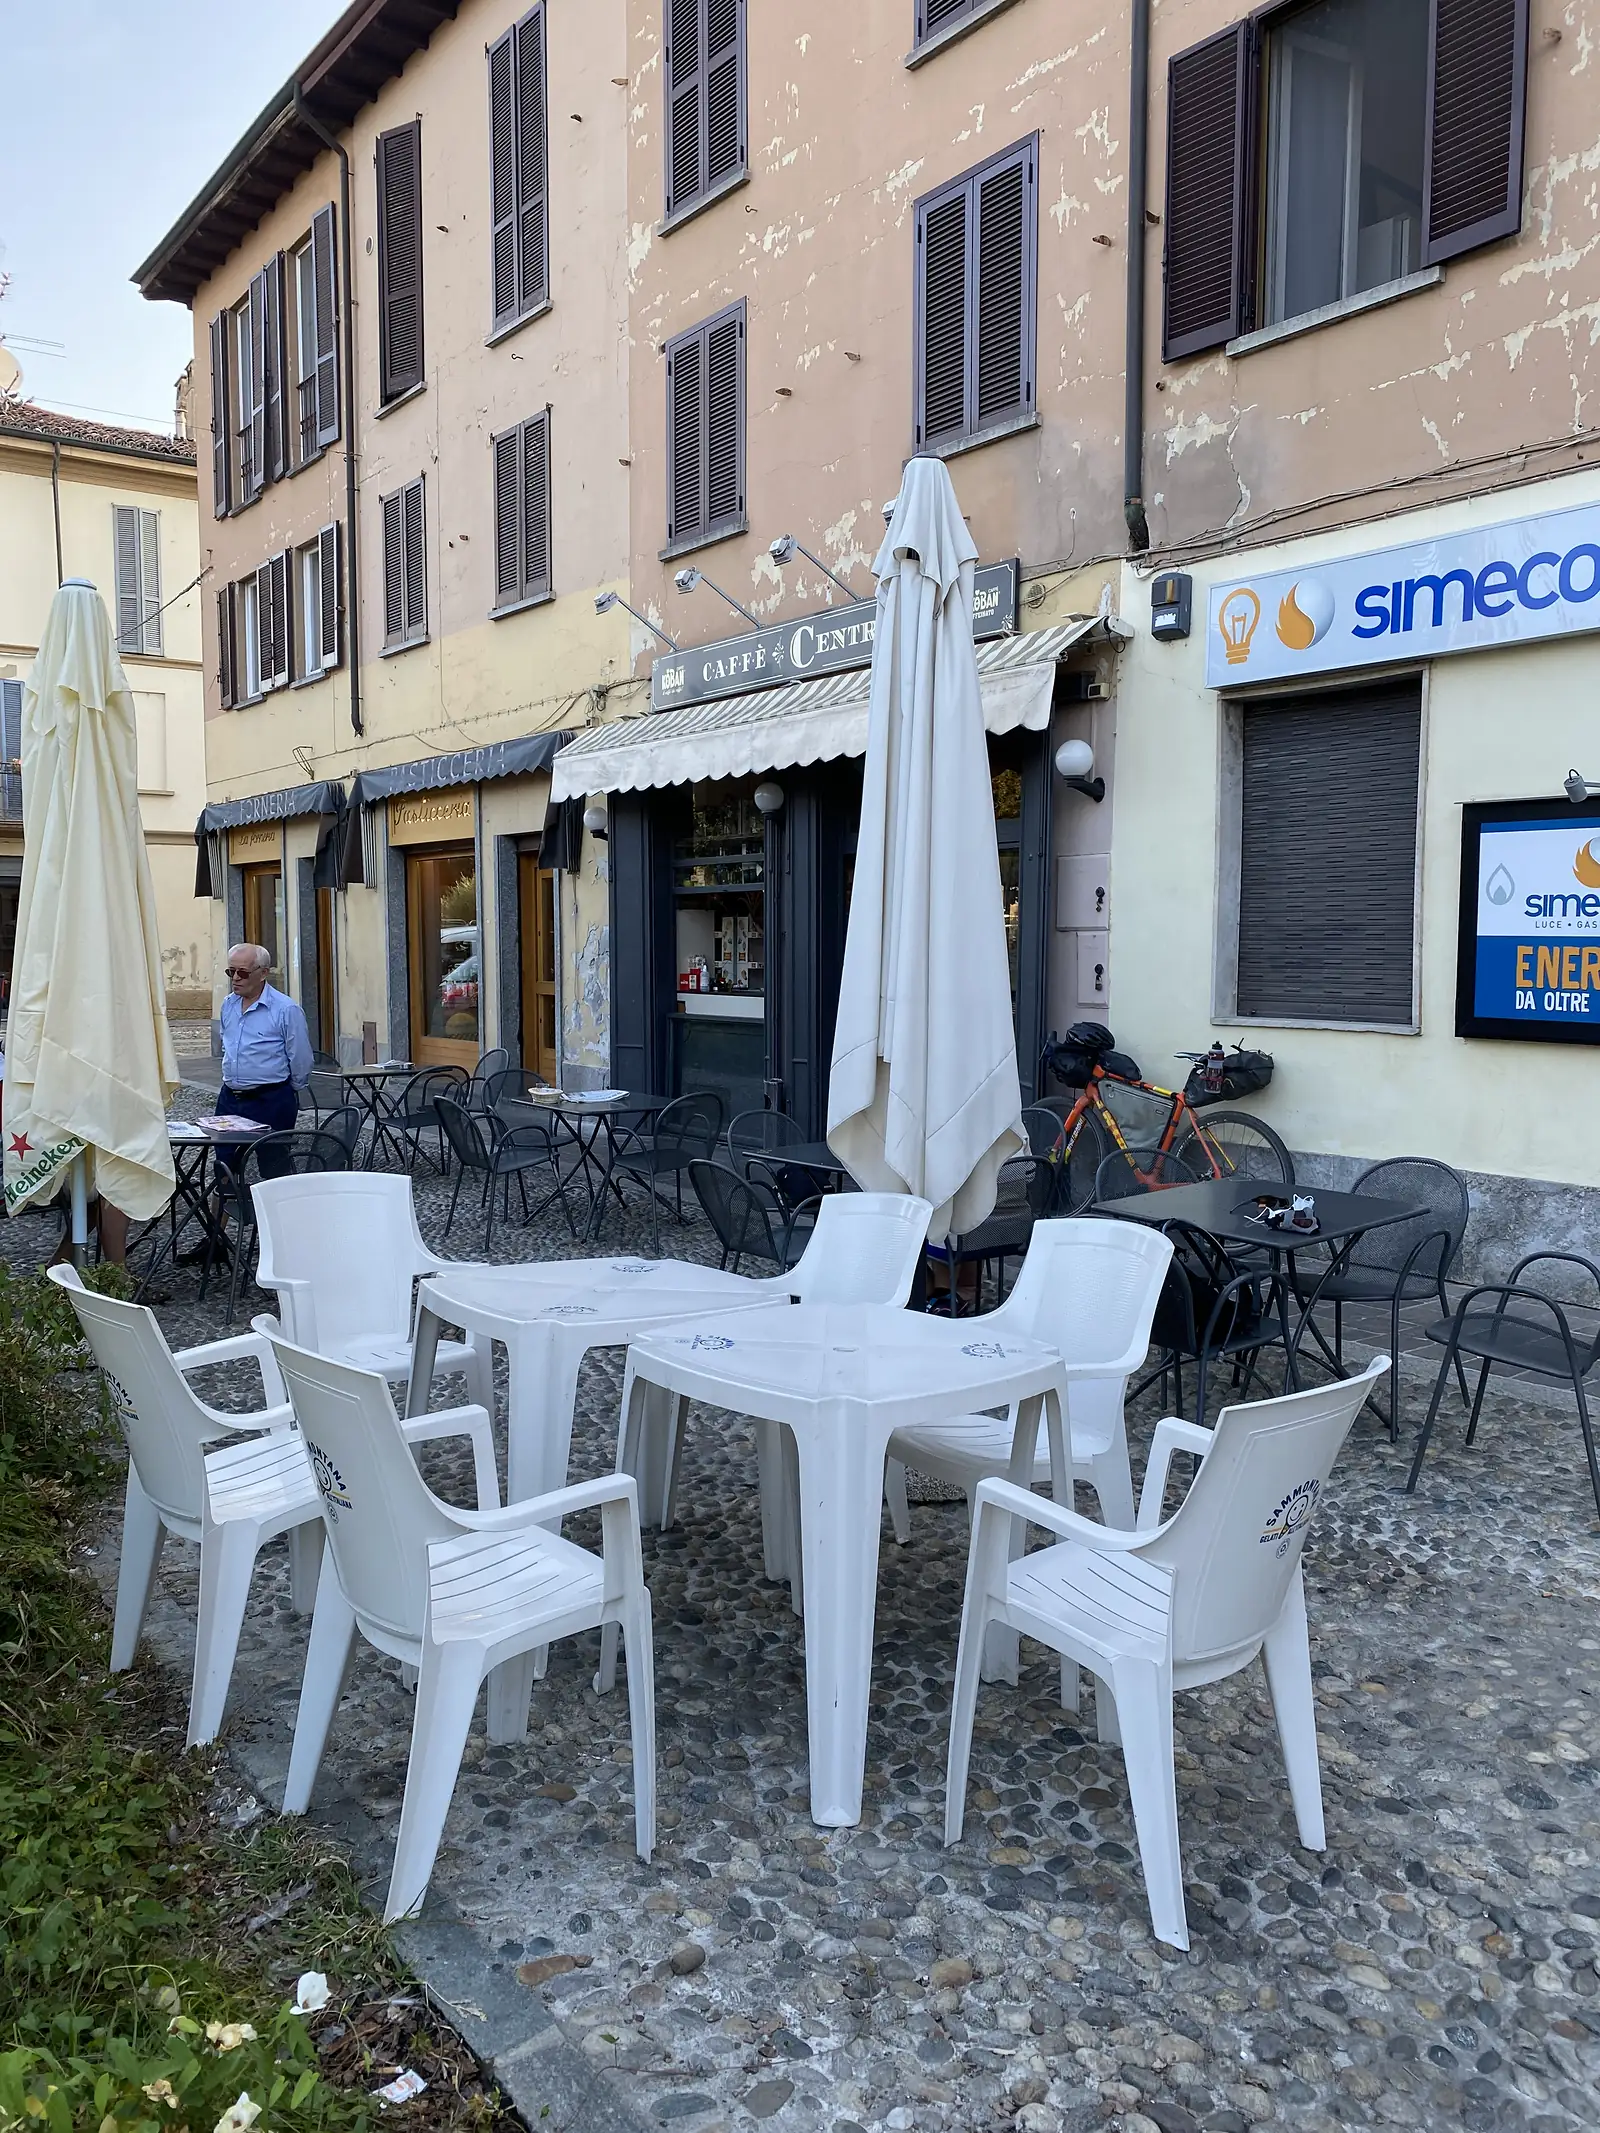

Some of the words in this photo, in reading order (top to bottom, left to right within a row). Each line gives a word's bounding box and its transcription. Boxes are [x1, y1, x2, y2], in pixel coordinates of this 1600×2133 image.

[1351, 543, 1600, 639] simeco
[790, 620, 877, 668] CENTR
[1524, 893, 1600, 917] sime
[1535, 920, 1562, 929] LUCE
[1576, 920, 1598, 929] GAS
[1515, 945, 1600, 991] ENER
[1515, 990, 1537, 1010] DA
[1543, 991, 1590, 1013] OLTRE
[4, 1136, 85, 1206] Heineken
